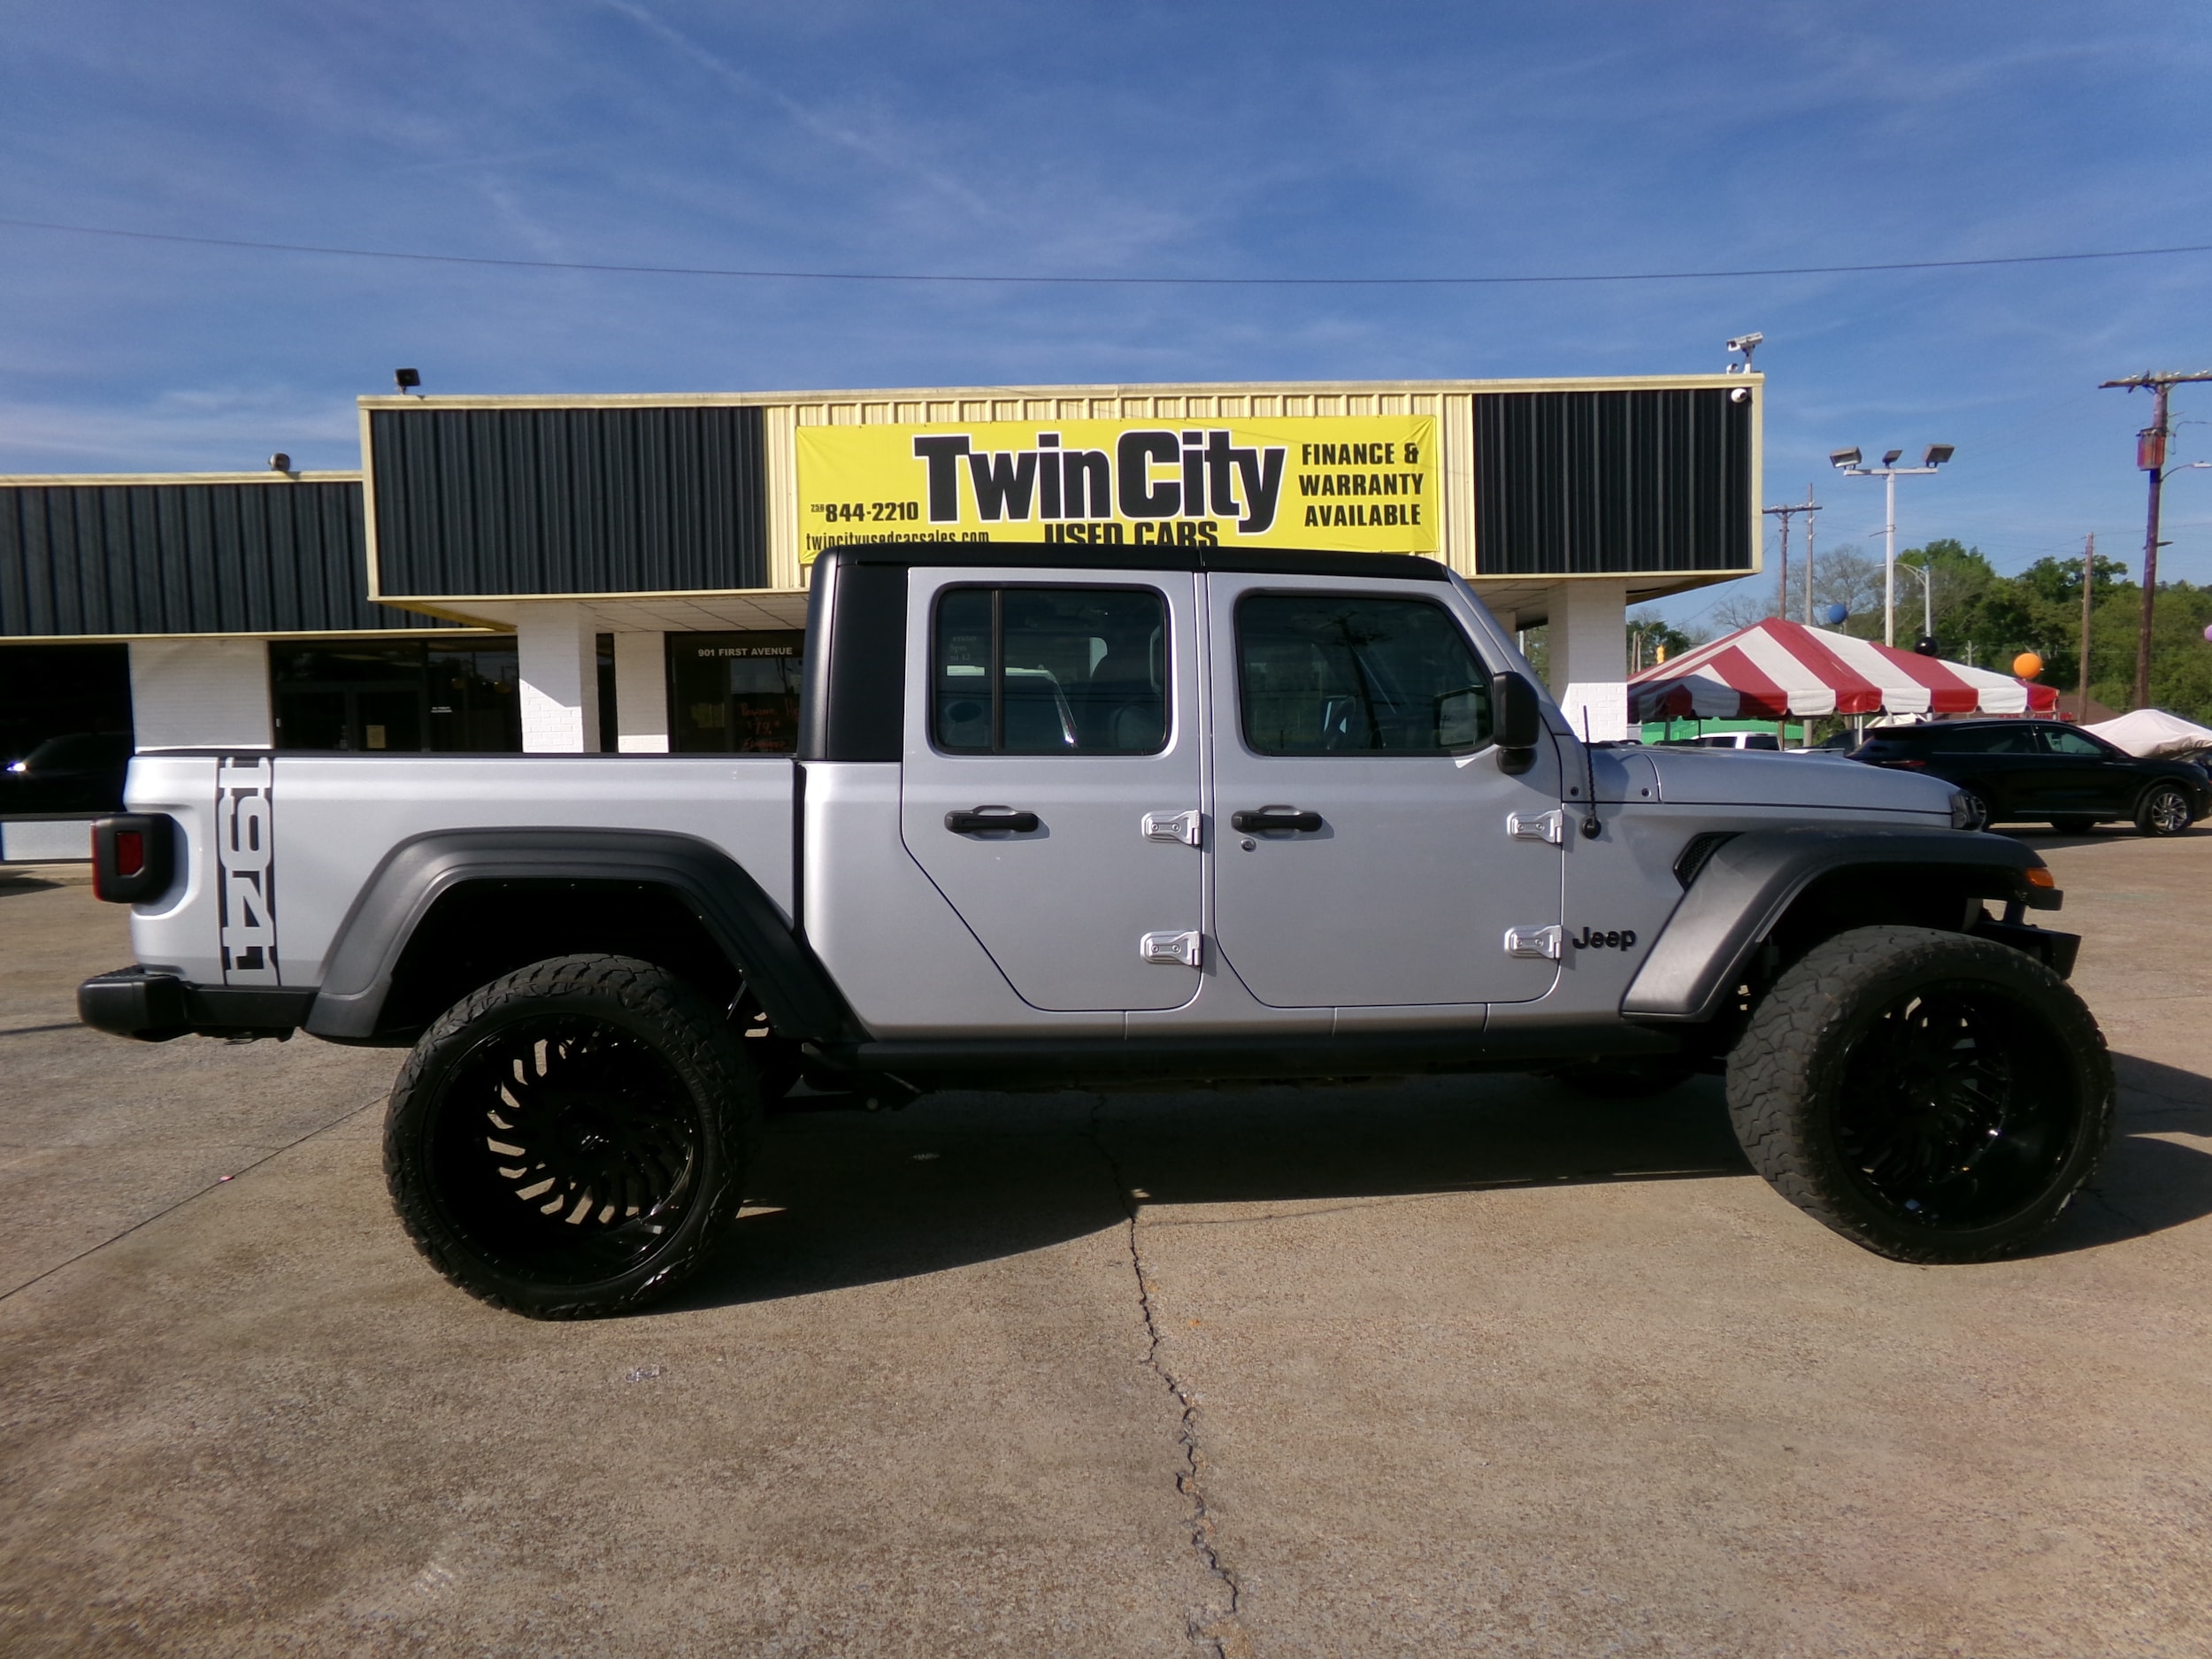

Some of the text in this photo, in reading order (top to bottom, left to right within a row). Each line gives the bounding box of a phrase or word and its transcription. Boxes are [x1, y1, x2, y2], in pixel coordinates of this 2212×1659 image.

[1302, 442, 1419, 465] FINANCE &
[1298, 472, 1424, 496] WARRANTY
[826, 502, 918, 523] 844-2210
[1304, 503, 1421, 527] AVAILABLE
[806, 530, 989, 550] twincityusedcarsalescom
[1044, 521, 1218, 547] USED CARS
[697, 647, 794, 657] 901 FIRST AVENUE
[1572, 926, 1636, 951] Jeep
